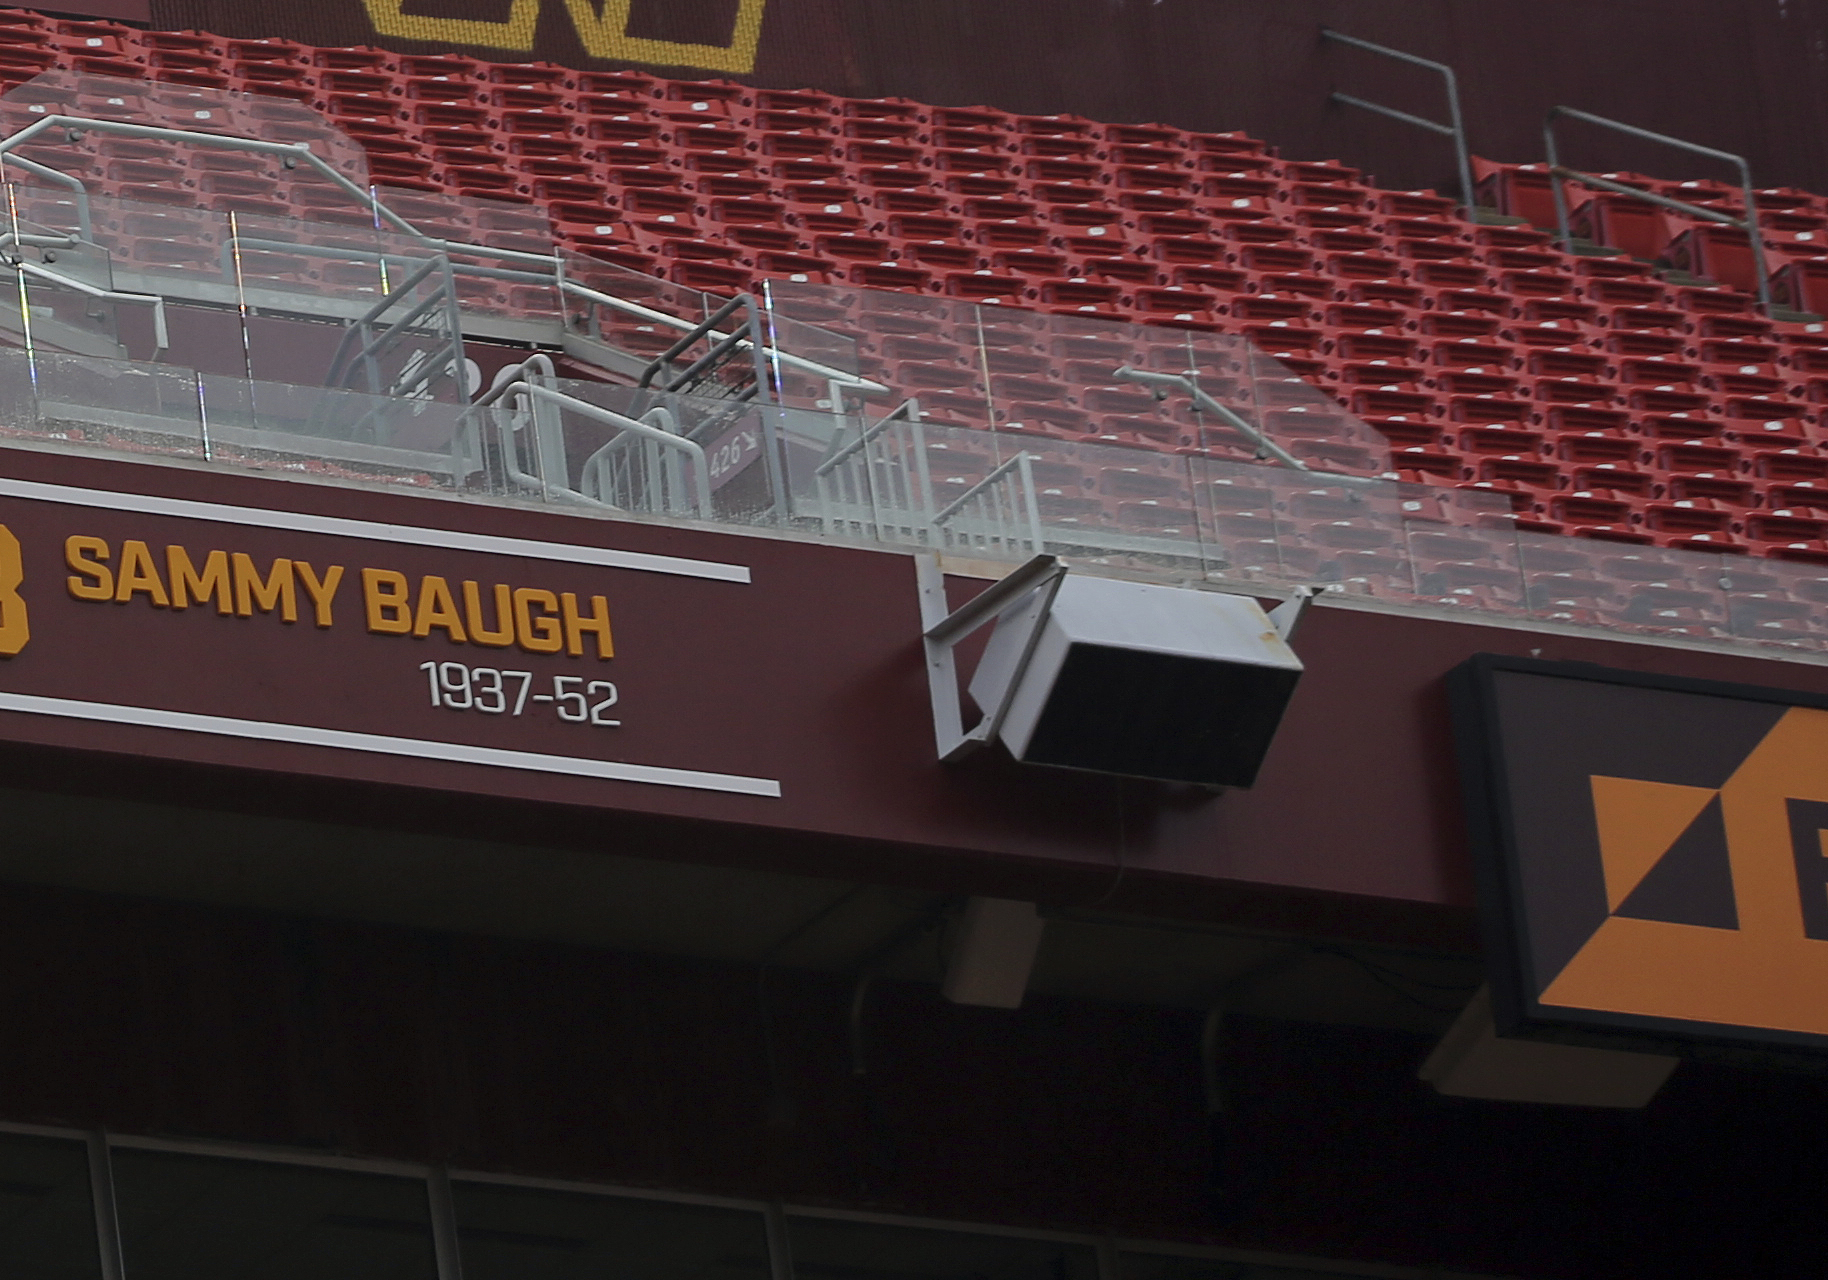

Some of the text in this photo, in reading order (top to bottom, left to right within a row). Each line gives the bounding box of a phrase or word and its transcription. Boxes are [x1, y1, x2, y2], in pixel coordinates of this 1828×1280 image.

[709, 434, 742, 479] 426
[63, 534, 348, 628] SAMMY
[360, 567, 617, 659] BAUGH
[418, 660, 623, 727] 1937-52
